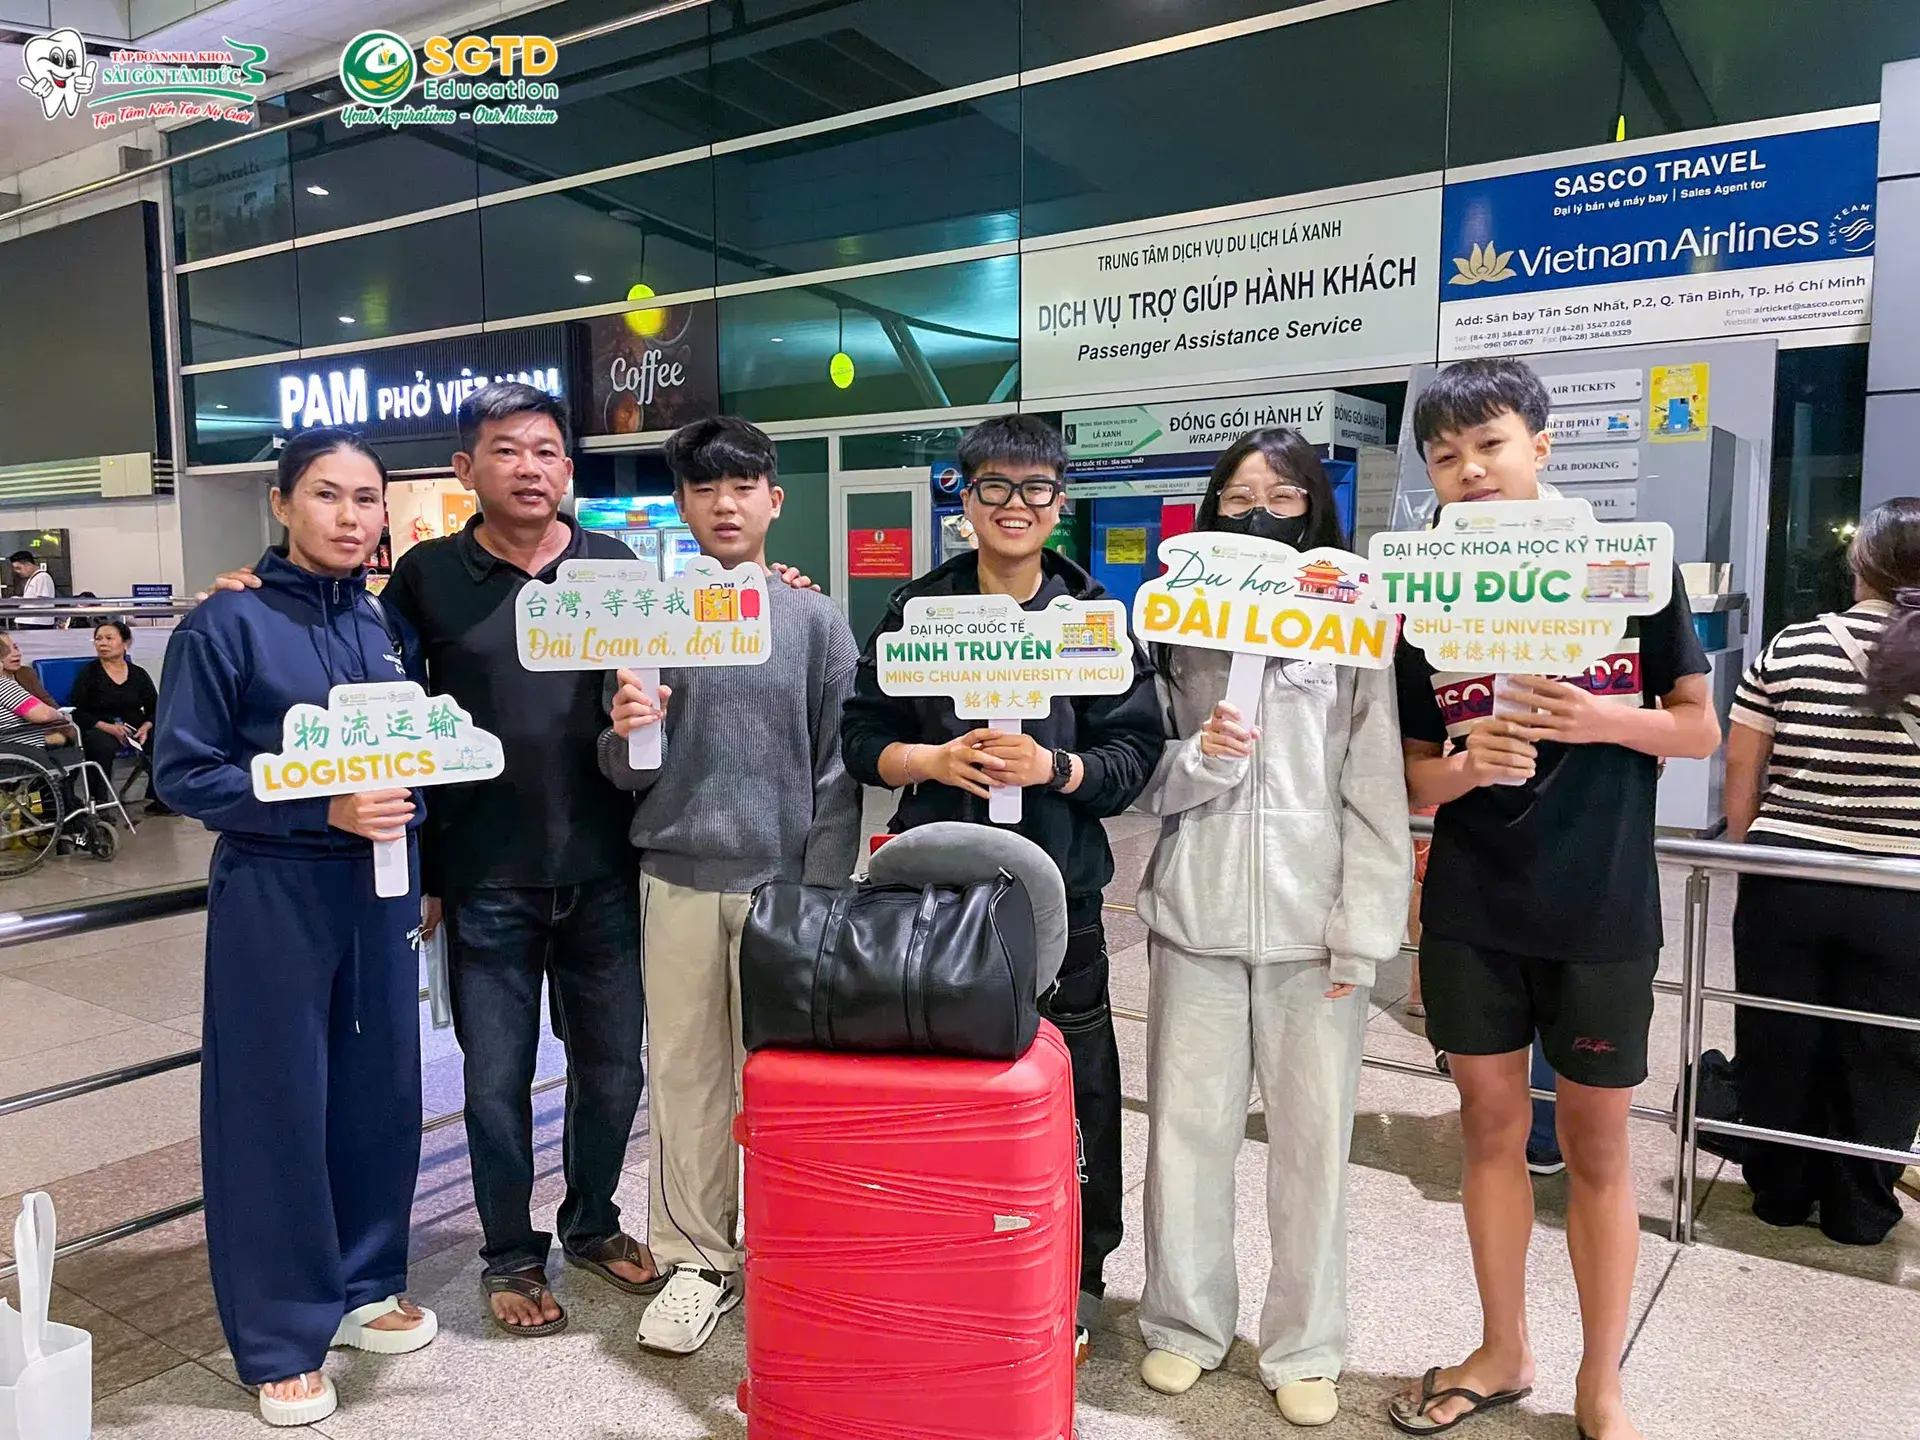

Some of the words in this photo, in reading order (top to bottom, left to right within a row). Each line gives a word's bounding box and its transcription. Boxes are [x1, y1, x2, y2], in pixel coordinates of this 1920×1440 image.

[1554, 166, 1648, 198] SASCO
[1655, 150, 1766, 183] TRAVEL
[1681, 187, 1711, 199] Sales
[1714, 182, 1748, 197] Agent
[1751, 179, 1768, 191] for
[1553, 203, 1572, 216] Đại
[1585, 199, 1606, 213] bán
[1623, 195, 1647, 208] máy
[1649, 192, 1668, 206] bay
[1097, 248, 1139, 272] TRUNG
[1142, 243, 1169, 264] TÂM
[1173, 240, 1202, 265] DỊCH
[1205, 238, 1224, 259] VỤ
[1227, 235, 1247, 254] DU
[1250, 231, 1278, 253] LỊCH
[1282, 222, 1299, 245] LÁ
[1302, 219, 1342, 243] XANH
[1518, 240, 1669, 278] Vietnam
[1671, 219, 1820, 262] Airlines
[1038, 300, 1087, 336] DỊCH
[1093, 295, 1121, 331] VỤ
[1129, 289, 1176, 324] TRỢ
[1183, 275, 1238, 312] GIÚP
[1245, 266, 1314, 306] HÀNH
[1323, 254, 1417, 297] KHÁCH
[1455, 316, 1484, 327] Add:
[1486, 313, 1509, 324] Sân
[1512, 311, 1536, 323] bay
[1538, 306, 1561, 318] Tân
[1564, 303, 1590, 316] Sơn
[1660, 295, 1675, 307] Q.
[1679, 292, 1703, 305] Tân
[1707, 286, 1745, 301] Bình,
[1748, 286, 1770, 299] Tp.
[1798, 278, 1824, 292] Chí
[1827, 275, 1867, 289] Minh
[1077, 337, 1171, 362] Passenger
[1174, 323, 1280, 352] Assistance
[1285, 316, 1363, 340] Service
[610, 349, 686, 406] Coffee
[1551, 384, 1569, 395] AIR
[1570, 382, 1616, 393] TICKETS
[280, 368, 368, 429] PAM
[378, 371, 432, 420] PHỞ
[1169, 409, 1217, 433] ĐÓNG
[1220, 406, 1249, 430] GÓI
[1254, 403, 1302, 426] HÀNH
[1307, 401, 1324, 422] LÝ
[1102, 429, 1122, 439] XANH
[1547, 463, 1568, 472] CAR
[1570, 460, 1620, 471] BOOKING
[1383, 543, 1411, 560] ĐẠI
[1417, 542, 1456, 560] HỌC
[1461, 540, 1512, 556] KHOA
[1518, 539, 1559, 559] HỌC
[1565, 535, 1590, 554] KỸ
[1595, 534, 1658, 556] THUẬT
[1166, 548, 1232, 592] Du
[1239, 564, 1295, 596] học
[1382, 571, 1461, 613] THỤ
[1474, 561, 1573, 604] ĐỨC
[910, 624, 932, 638] ĐẠI
[936, 623, 964, 639] HỌC
[967, 619, 1007, 636] QUỐC
[1010, 618, 1026, 633] TẾ
[1143, 587, 1233, 640] ĐÀI
[1244, 604, 1388, 659] LOAN
[1413, 618, 1485, 634] SHU-TE
[1492, 618, 1613, 636] UNIVERSITY
[528, 627, 575, 660] Đài
[581, 626, 643, 663] Loan
[886, 642, 949, 662] MINH
[955, 632, 1052, 661] TRUYỀN
[886, 671, 925, 683] MING
[928, 670, 981, 683] CHUAN
[986, 668, 1074, 682] UNIVERSITY
[1078, 667, 1125, 682] (MCU)
[294, 703, 464, 751] 物流运输
[263, 750, 436, 791] LOGISTICS
